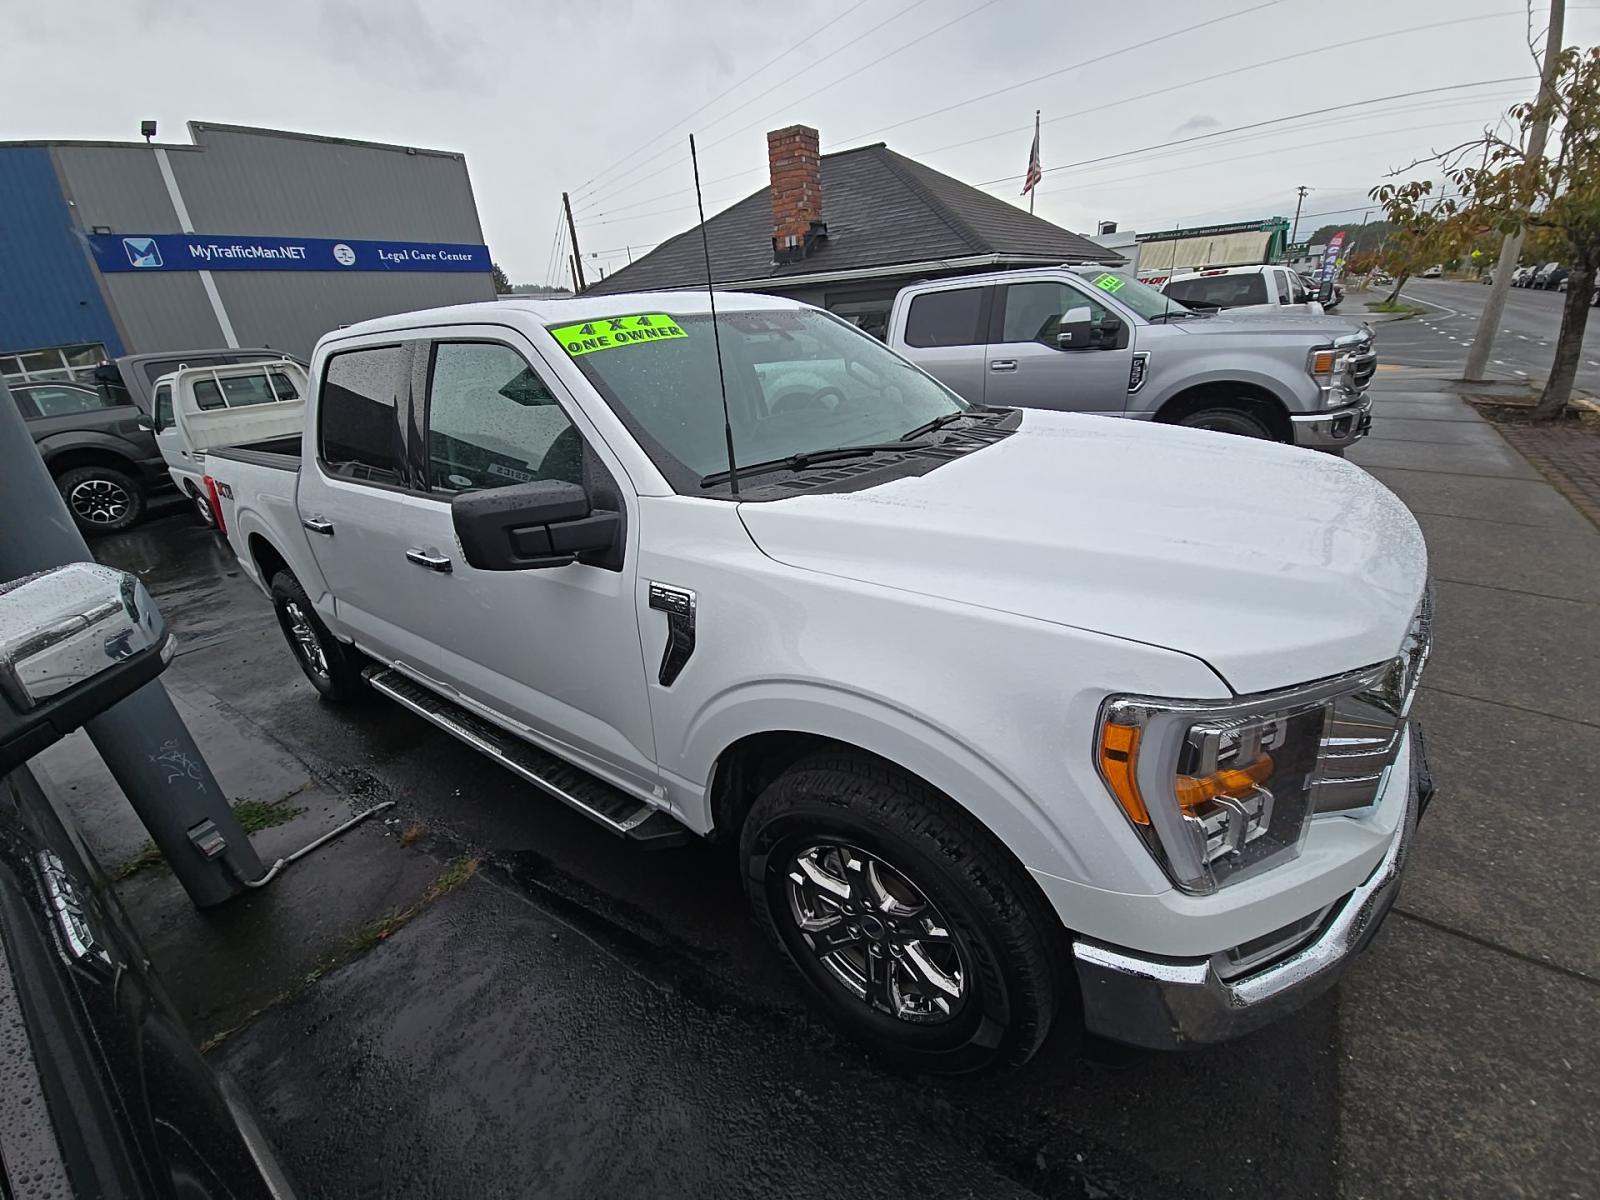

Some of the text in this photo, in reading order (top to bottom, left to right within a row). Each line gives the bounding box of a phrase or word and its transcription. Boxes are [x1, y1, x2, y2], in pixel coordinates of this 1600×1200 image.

[188, 244, 306, 260] MyTrafficMan.NET
[378, 249, 473, 263] Legal Care Center
[579, 315, 652, 335] 4 X 4
[567, 326, 684, 353] ONE OWNER
